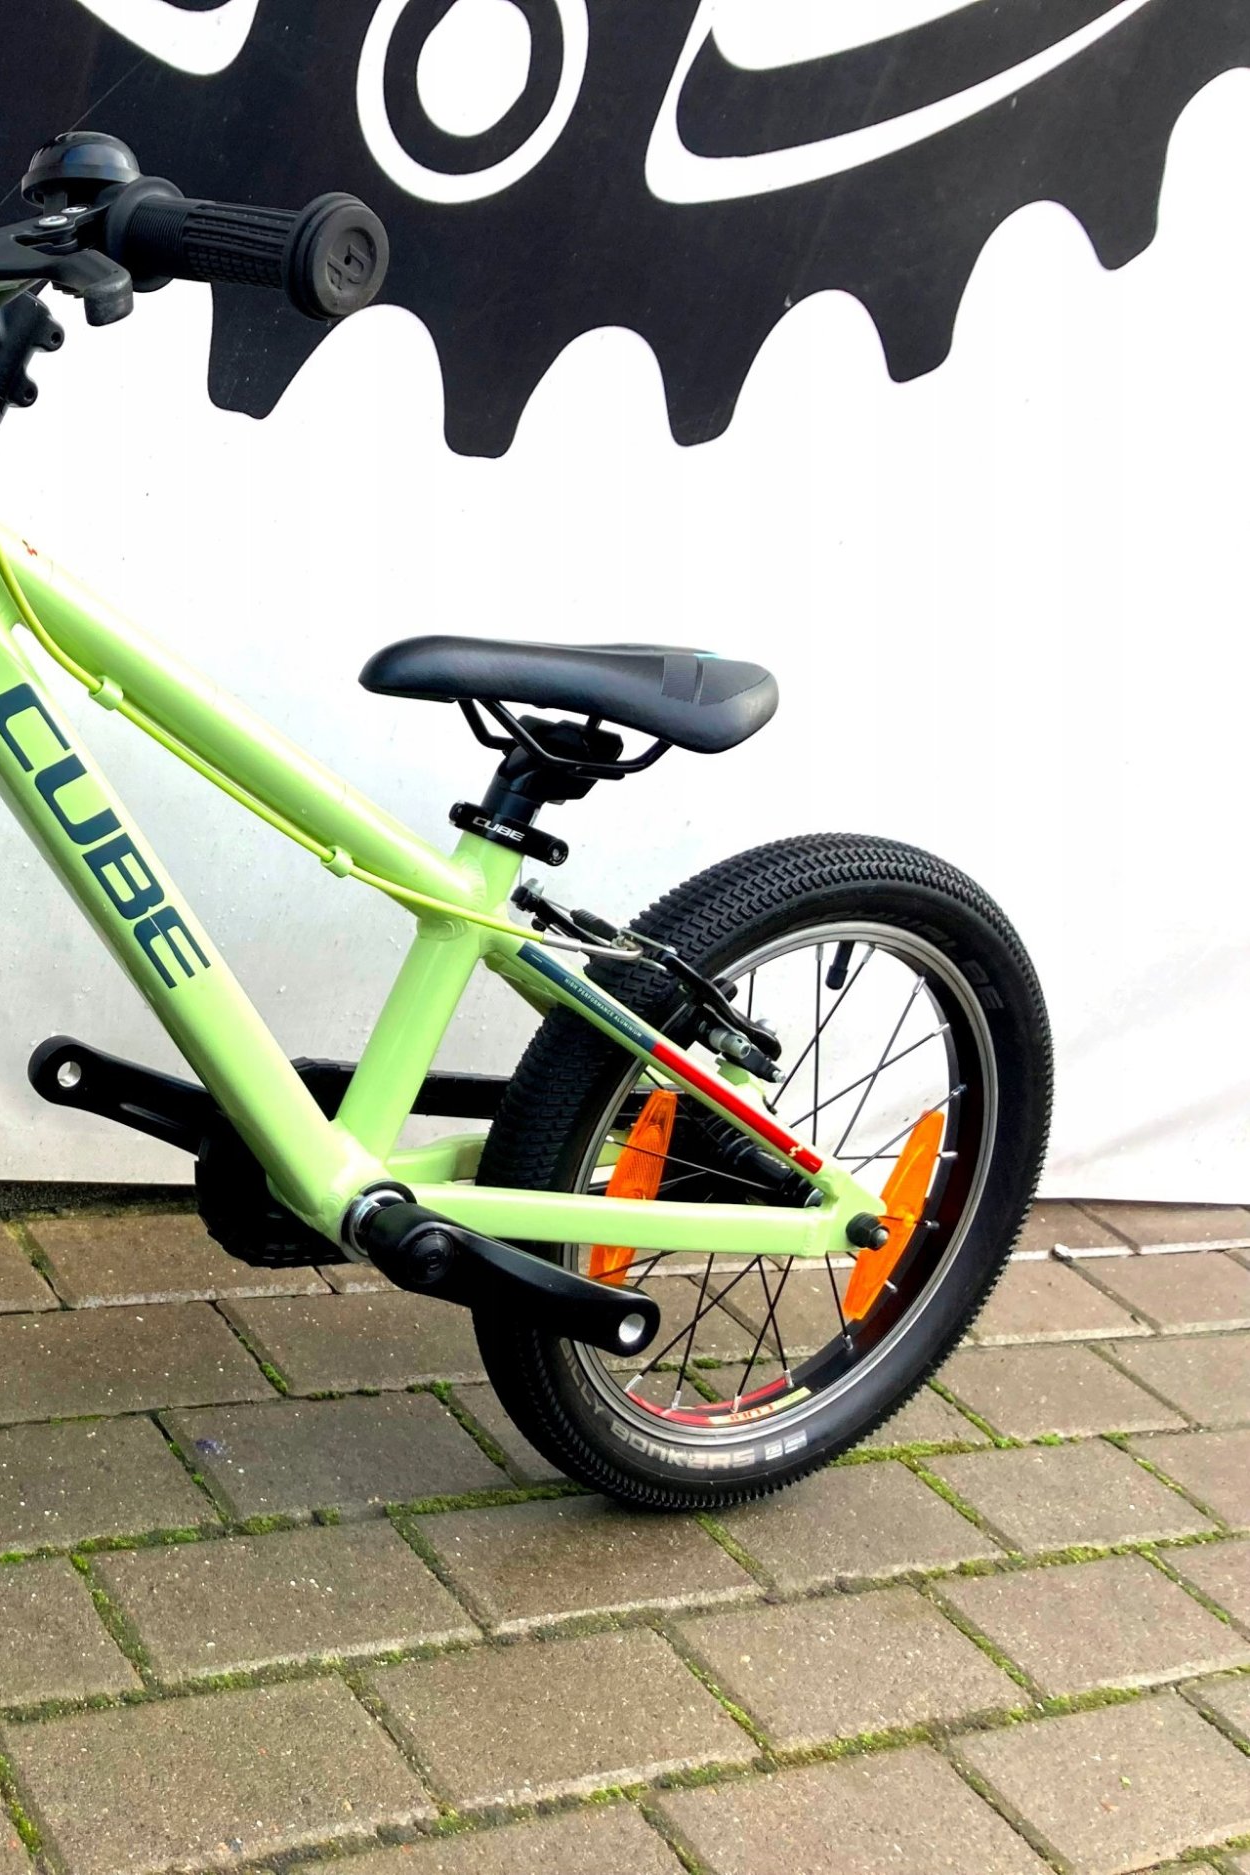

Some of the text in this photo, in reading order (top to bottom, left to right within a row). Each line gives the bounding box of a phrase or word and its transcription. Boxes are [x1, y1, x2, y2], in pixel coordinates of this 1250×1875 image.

[473, 816, 526, 843] CUBE
[564, 977, 643, 1038] HIGH PERFORMANCE ALUMINIUM
[610, 1419, 756, 1470] BONKERS
